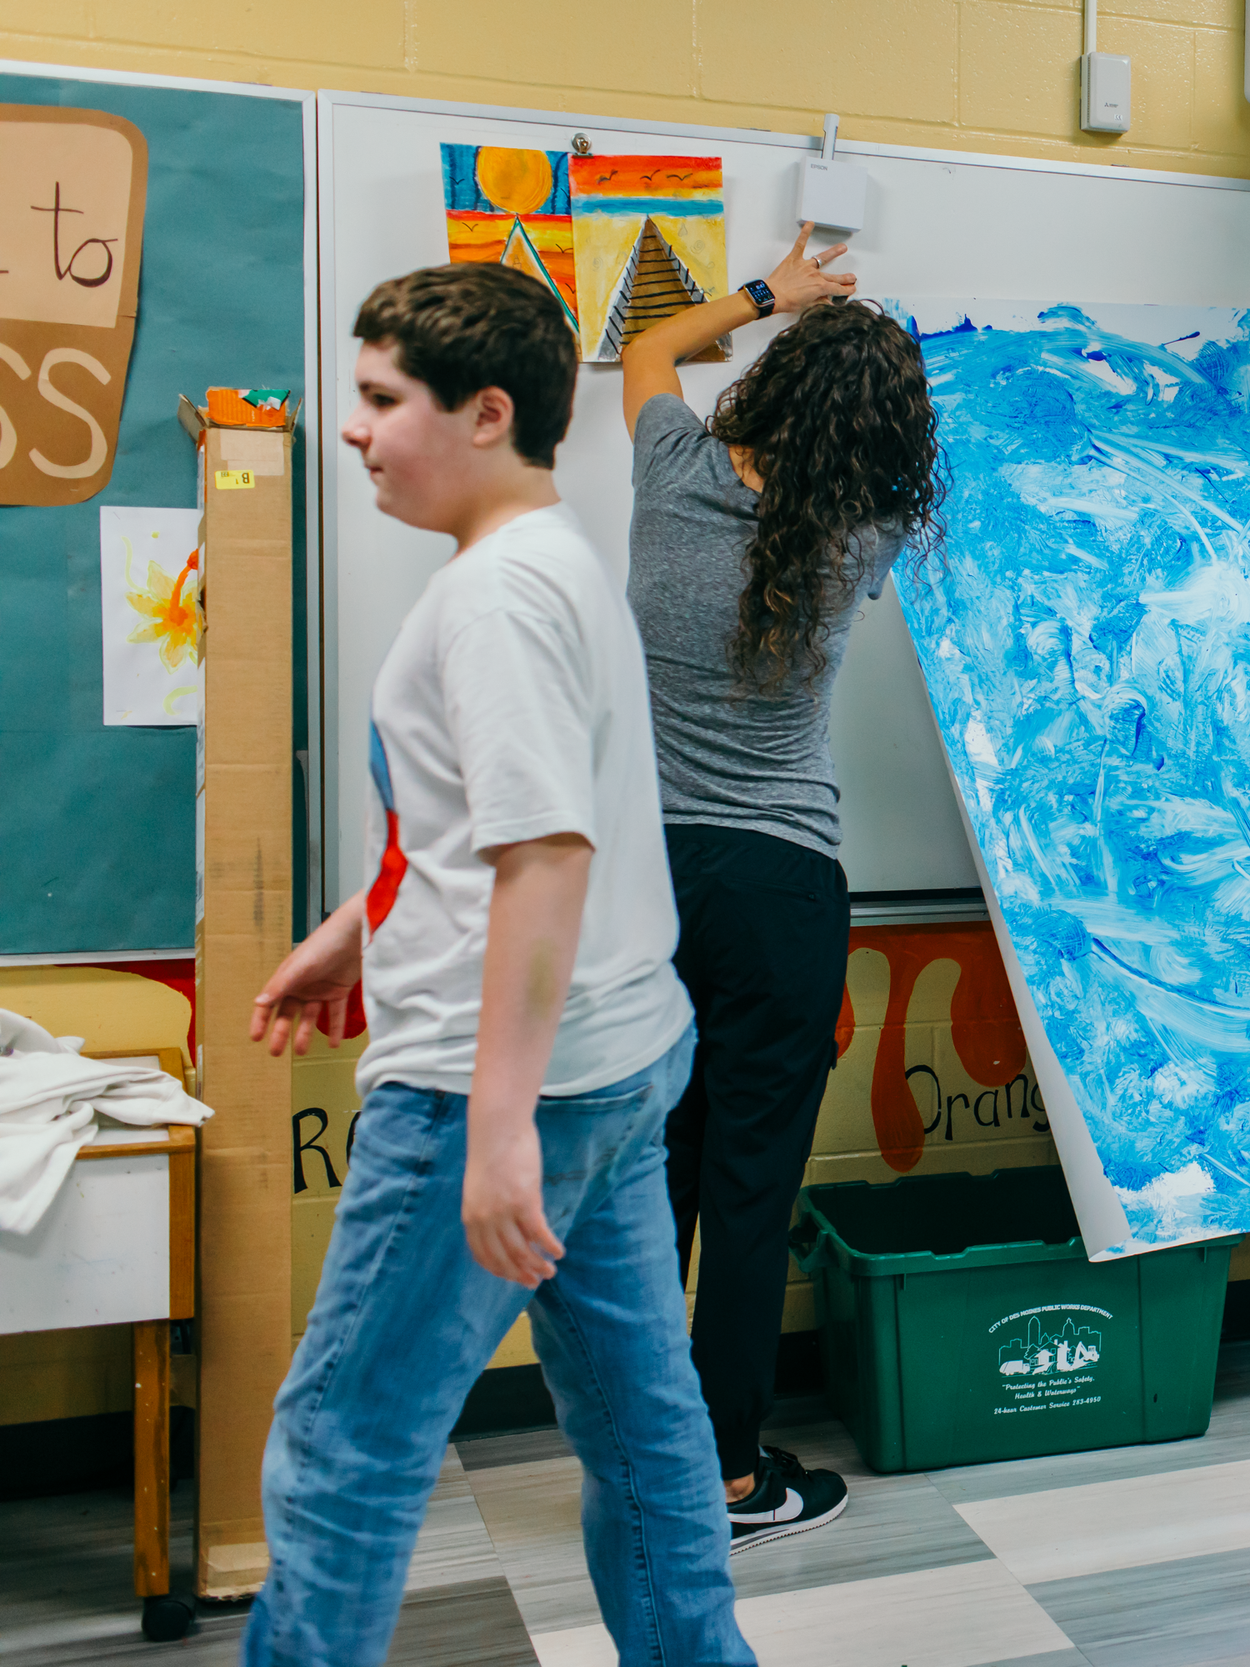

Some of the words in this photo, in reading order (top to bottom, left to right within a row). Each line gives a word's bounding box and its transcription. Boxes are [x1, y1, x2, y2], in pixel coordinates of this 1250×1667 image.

[810, 163, 829, 171] EPSON
[31, 181, 118, 288] to
[988, 1320, 1002, 1334] CITY
[1001, 1316, 1009, 1324] OF
[1020, 1306, 1042, 1317] MOINES
[1041, 1304, 1061, 1312] PUBLIC
[1080, 1304, 1114, 1320] DEPARTMENT
[1037, 1380, 1047, 1388] the
[1049, 1377, 1072, 1386] Public's
[1014, 1391, 1035, 1400] Health
[993, 1406, 1017, 1415] 24-hour
[1019, 1404, 1047, 1412] Customer
[1049, 1401, 1070, 1409] Service
